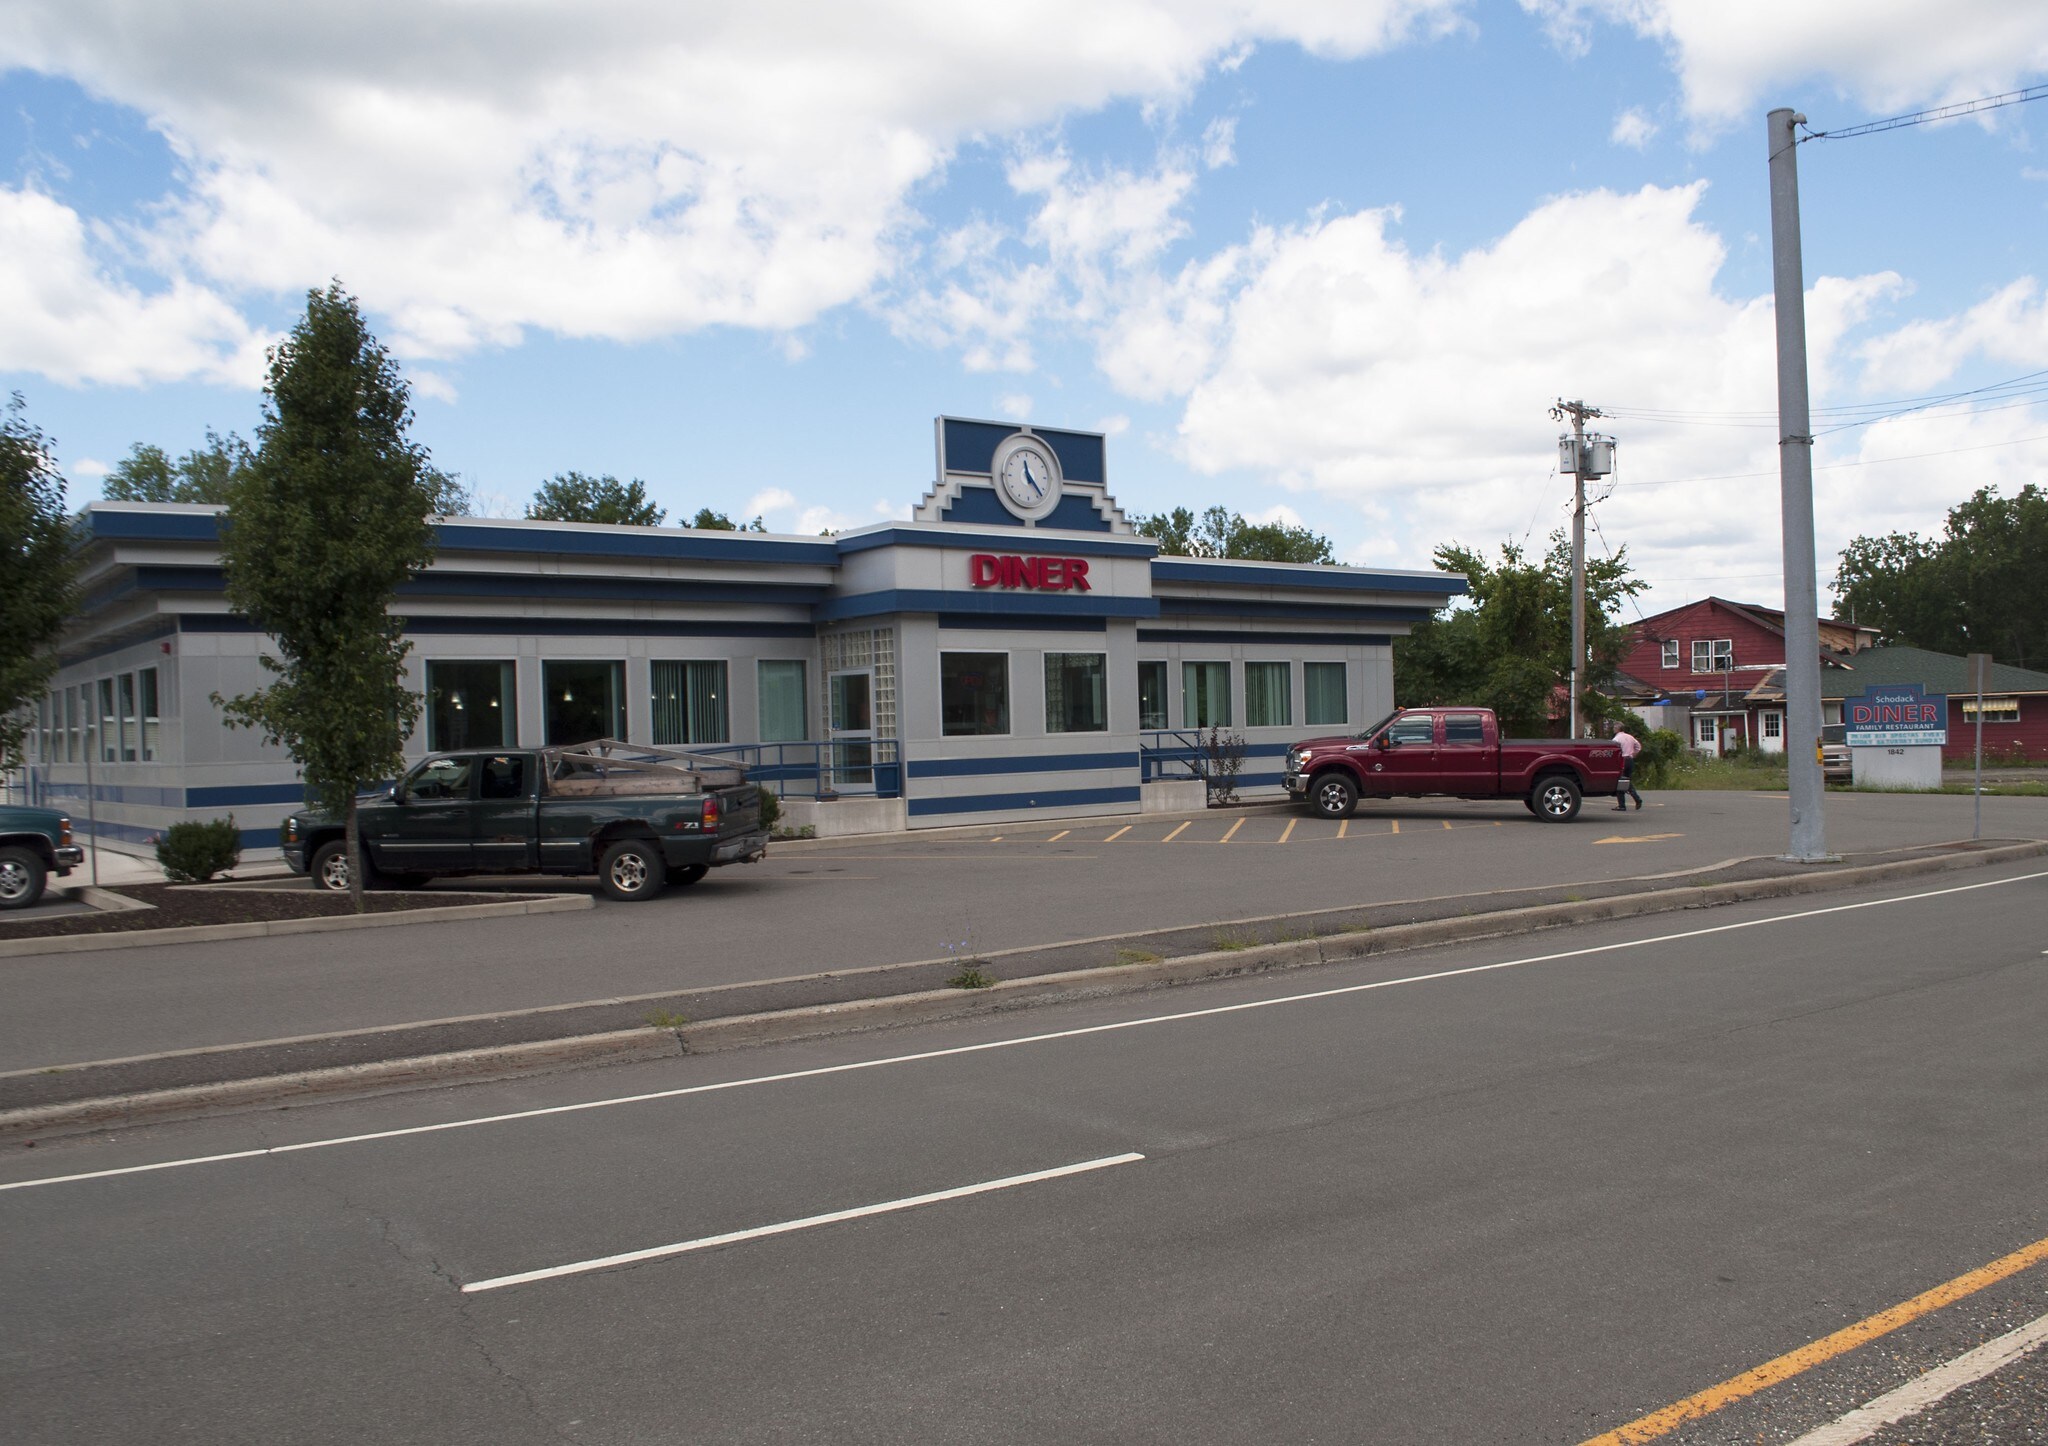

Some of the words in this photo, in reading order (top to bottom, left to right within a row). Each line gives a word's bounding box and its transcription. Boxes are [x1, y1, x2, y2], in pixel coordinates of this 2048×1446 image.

[971, 554, 1092, 591] DINER
[1875, 695, 1914, 703] Schodack
[1853, 704, 1937, 723] DINER
